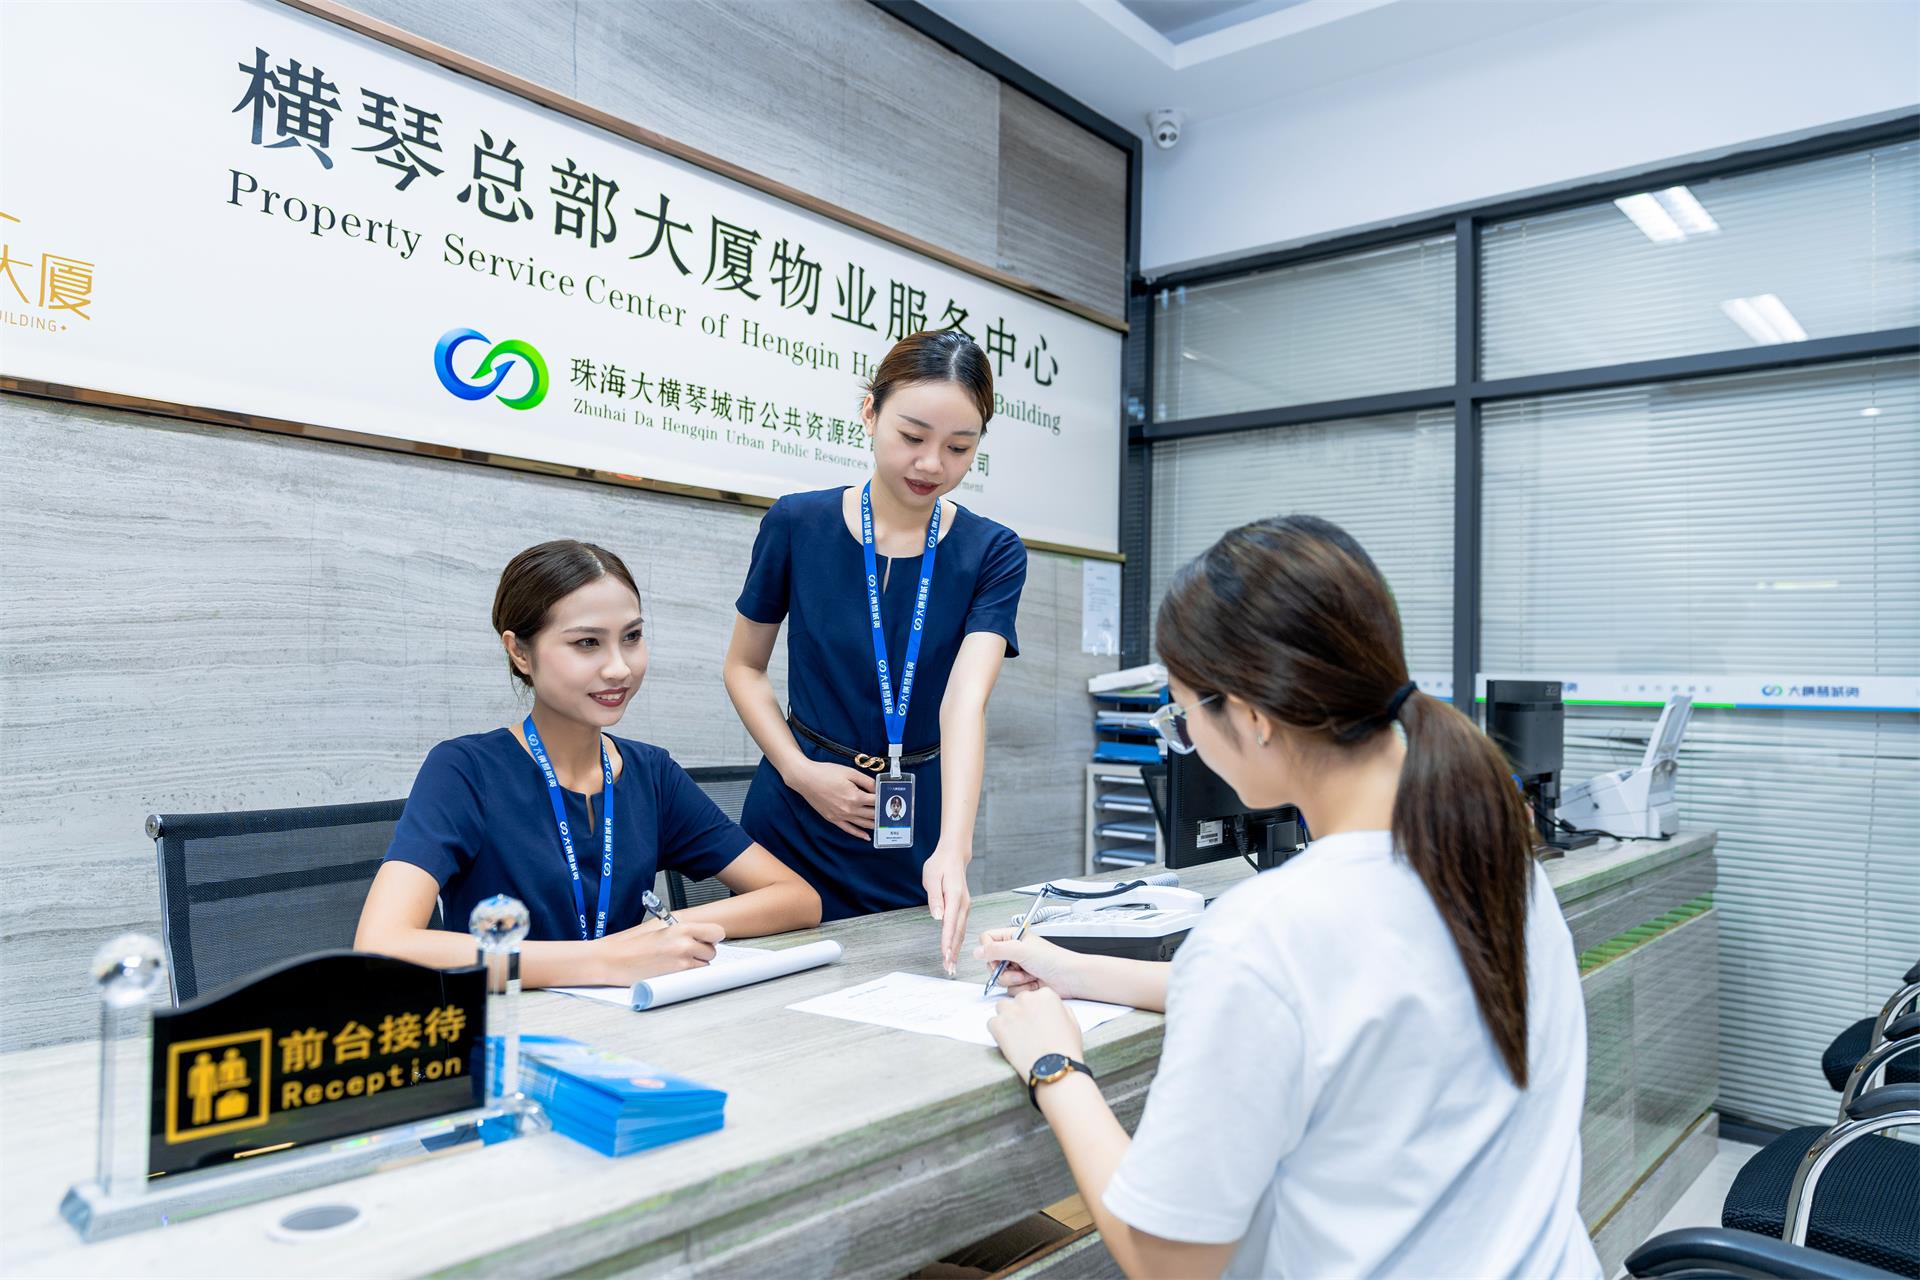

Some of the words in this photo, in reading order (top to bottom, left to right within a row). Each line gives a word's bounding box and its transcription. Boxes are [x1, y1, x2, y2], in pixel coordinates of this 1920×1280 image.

[0, 310, 57, 333] ILDING
[227, 169, 422, 260] Property
[443, 233, 575, 297] Service
[585, 275, 687, 327] Center
[701, 314, 730, 340] of
[742, 319, 840, 372] Hengqin
[993, 393, 1061, 436] Building
[574, 398, 626, 423] Zhuhai
[635, 410, 653, 427] Da
[663, 416, 718, 442] Hengqin
[726, 429, 765, 450] Urban
[772, 439, 808, 459] Public
[814, 447, 868, 470] Resources
[278, 1004, 466, 1074] 前台接待
[281, 1056, 462, 1110] Reception
